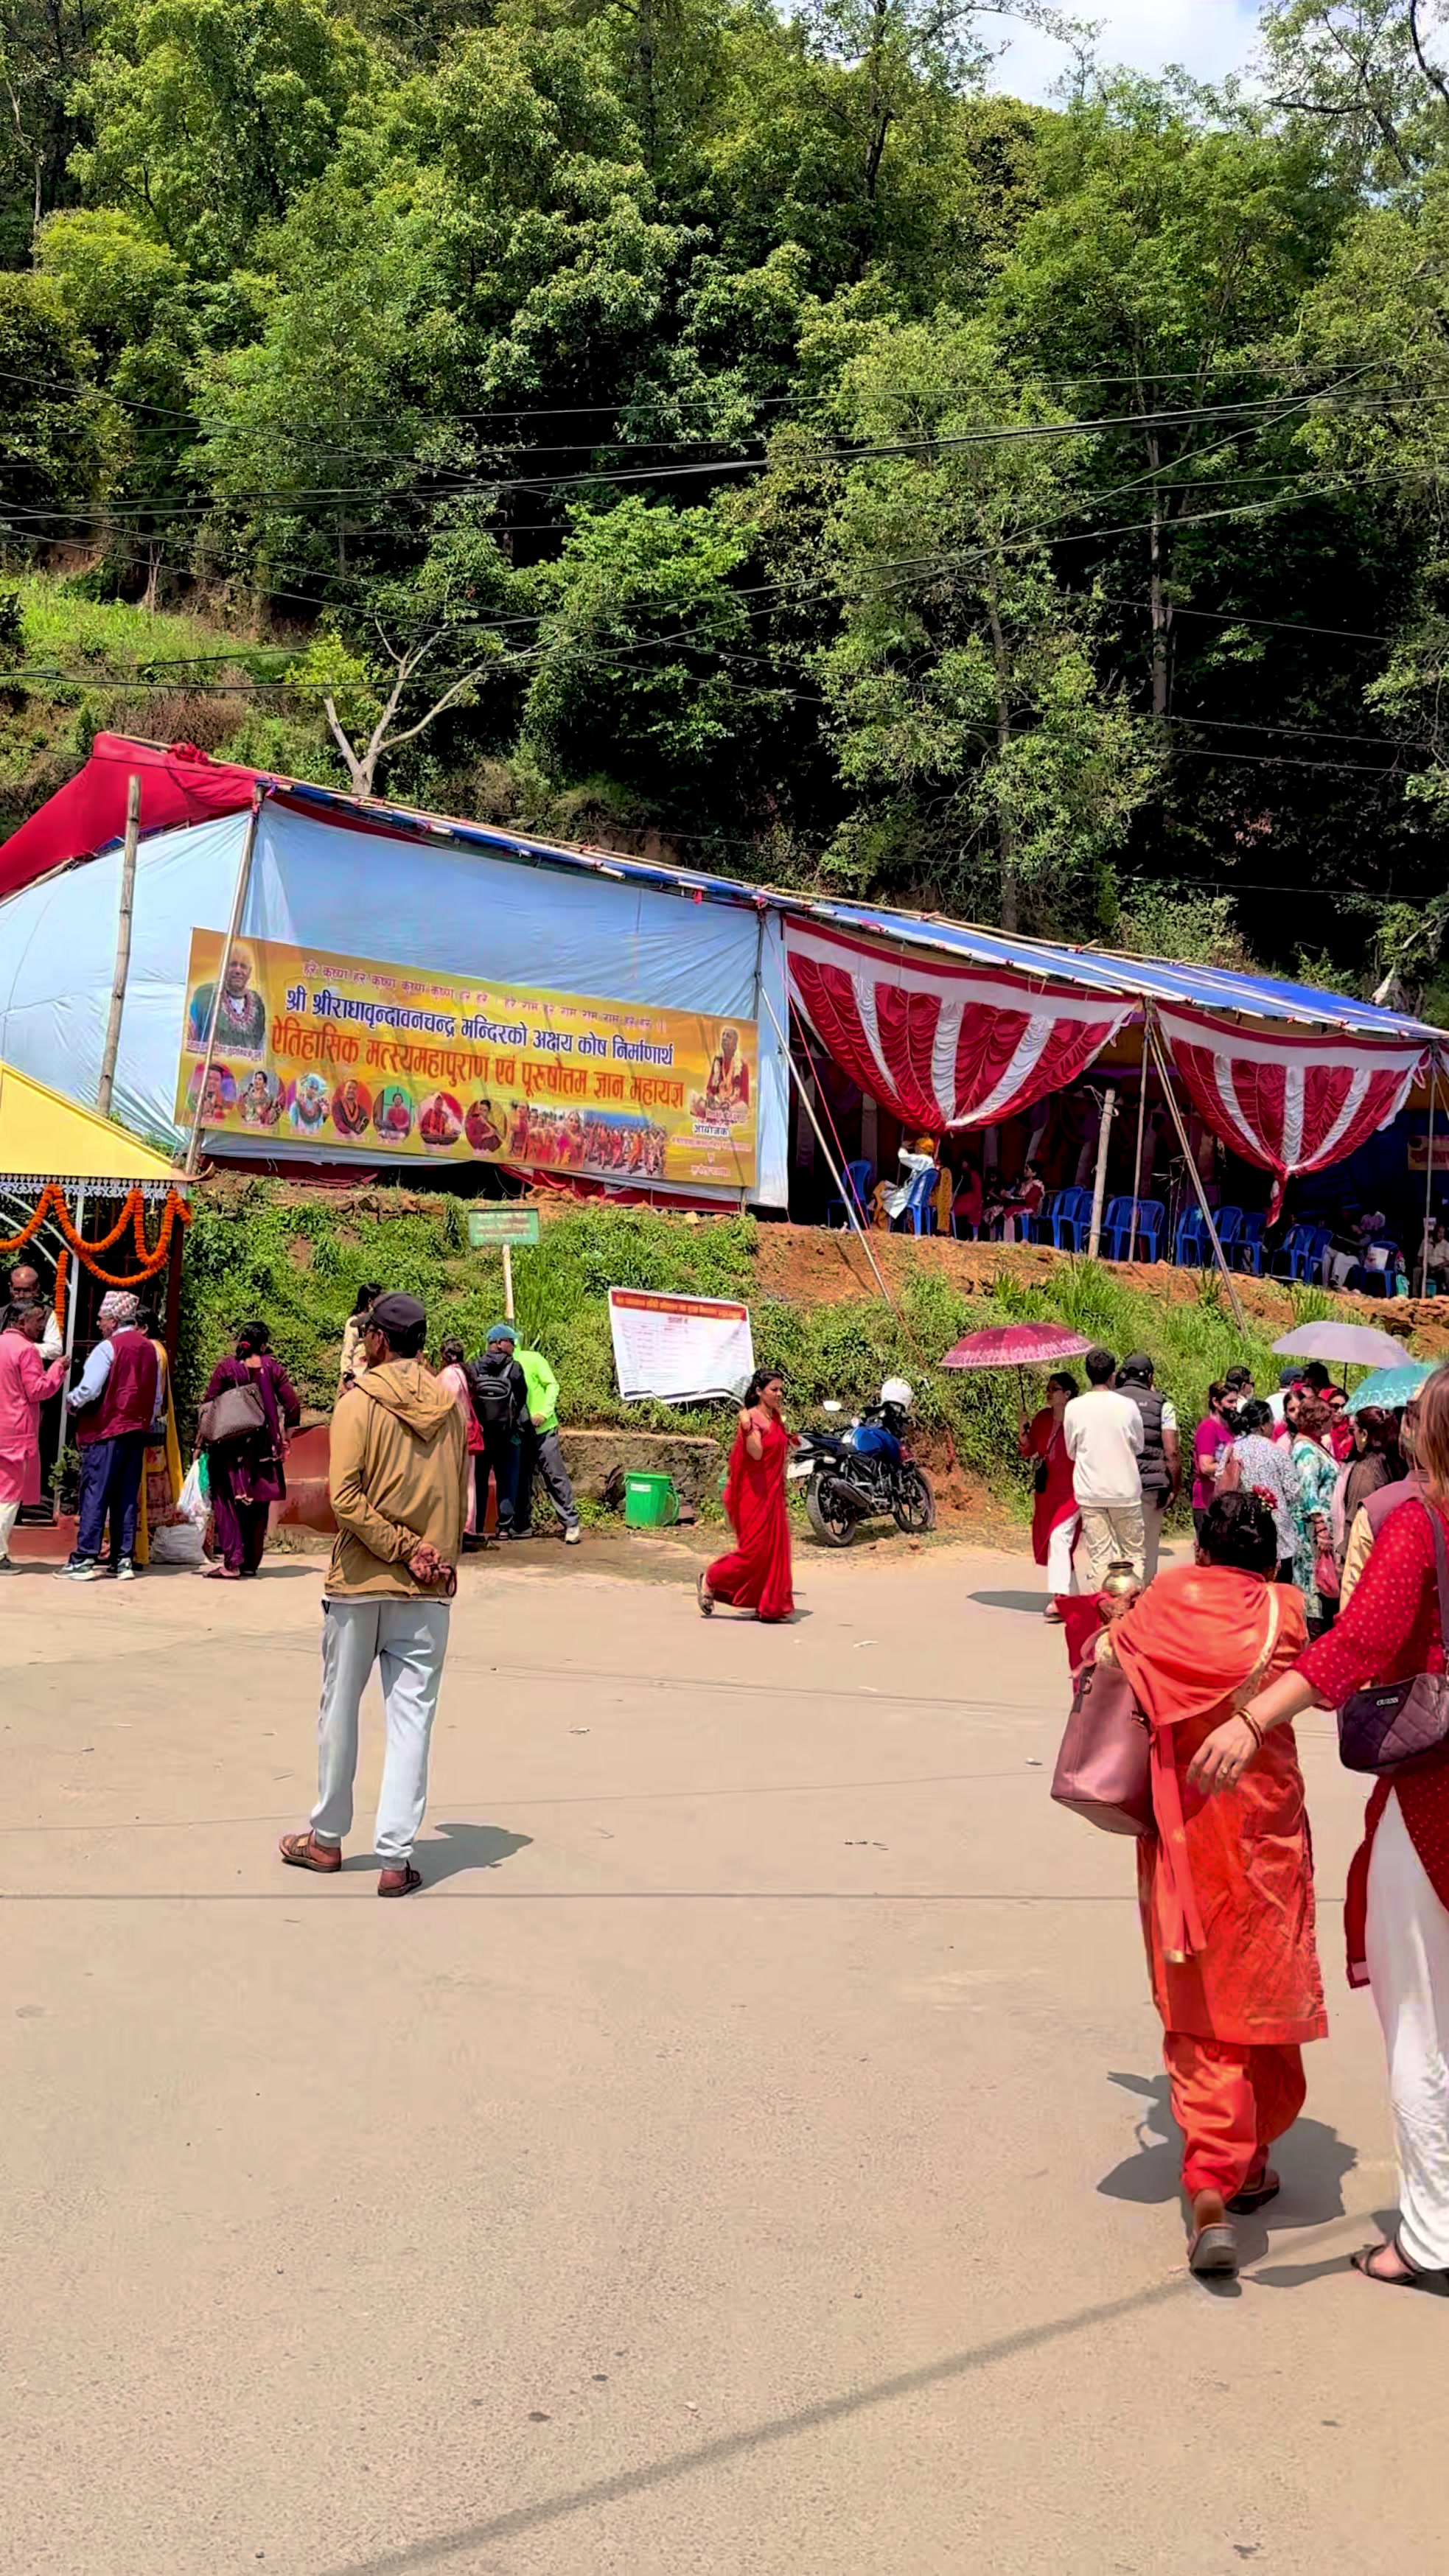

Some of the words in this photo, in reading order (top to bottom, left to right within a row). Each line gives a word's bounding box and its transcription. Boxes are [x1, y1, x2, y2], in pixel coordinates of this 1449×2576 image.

[271, 1015, 361, 1064] ऐतिहासिक
[366, 1038, 489, 1087] मत्स्यमहापुराण
[495, 1056, 517, 1086] एवं
[593, 1071, 626, 1100] ज्ञान
[630, 1075, 685, 1108] महायज्ञ
[286, 984, 307, 1012] श्री
[313, 988, 456, 1037] श्रीराधावृन्दावनचन्द्र
[461, 1014, 528, 1046] मन्दिरको
[534, 1029, 573, 1053] अक्षय
[578, 1032, 608, 1057] कोष
[612, 1034, 673, 1065] निर्माणार्थ
